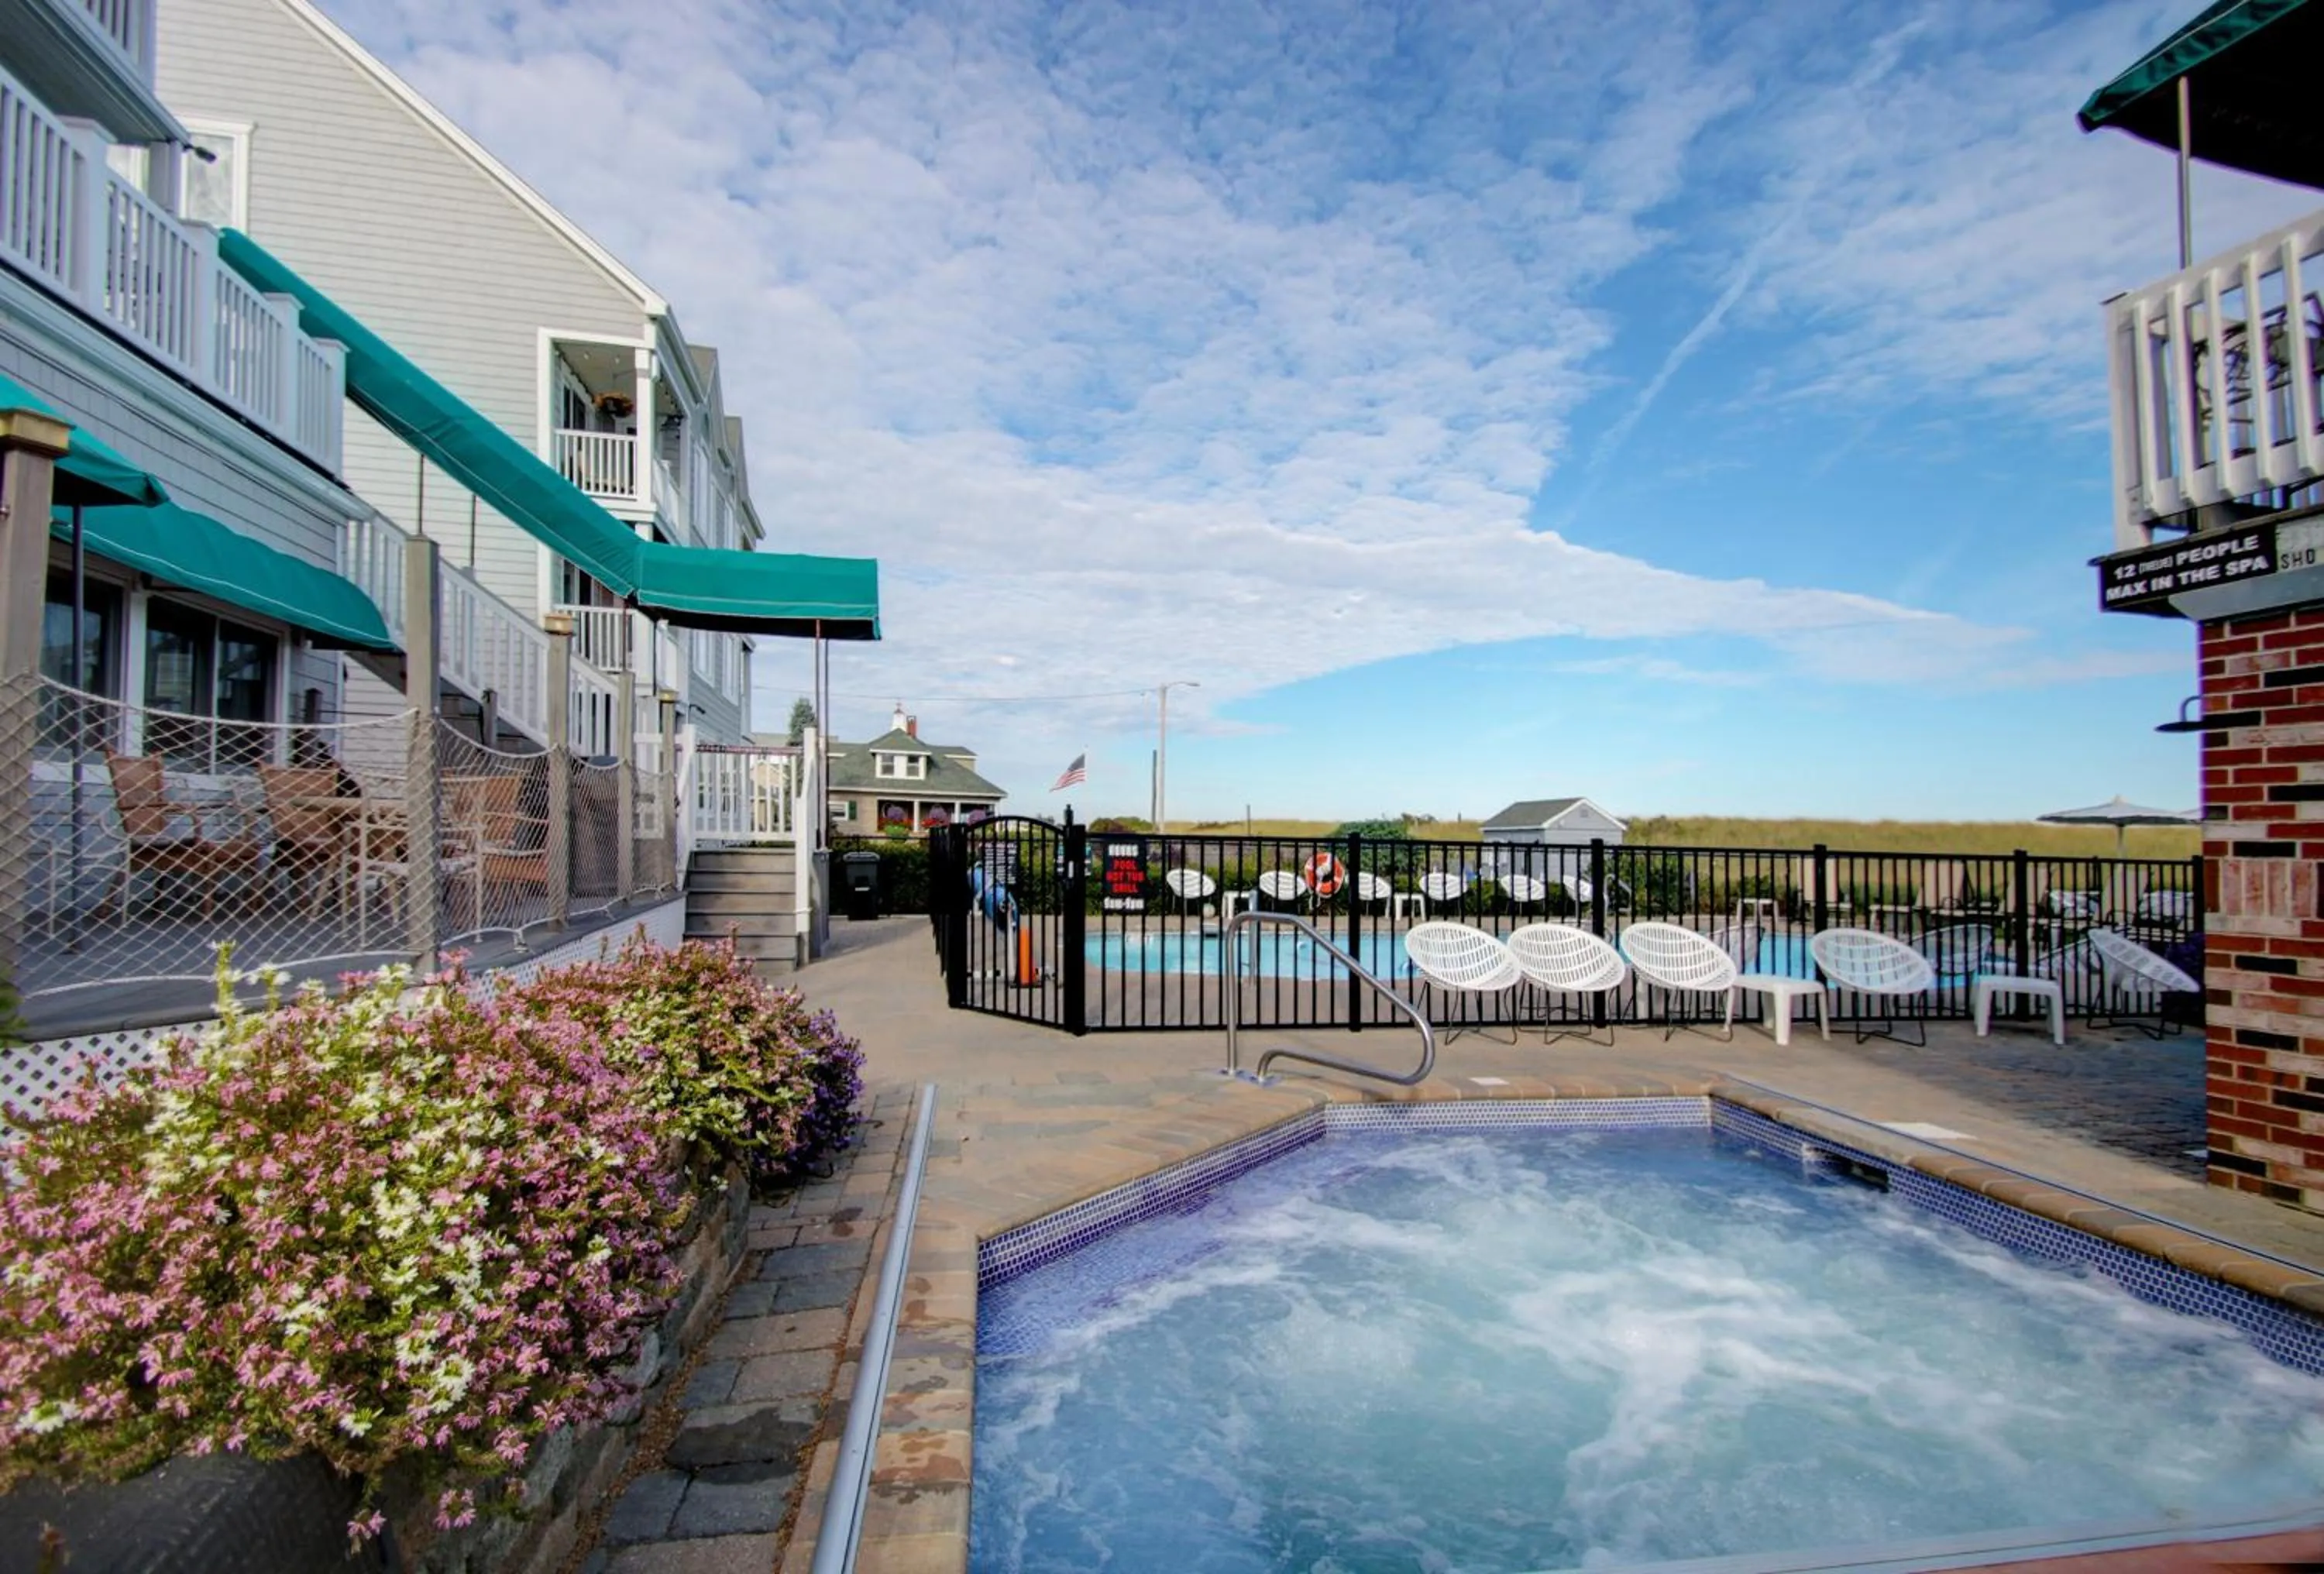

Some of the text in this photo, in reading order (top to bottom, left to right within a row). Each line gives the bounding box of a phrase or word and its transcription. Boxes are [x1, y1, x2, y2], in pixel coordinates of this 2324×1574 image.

[2113, 563, 2137, 580] 12
[2175, 534, 2260, 566] PEOPLE
[2106, 555, 2269, 601] MAX IN THE SPA
[1105, 871, 1144, 882] HOT TUB
[1113, 860, 1137, 870] POOL
